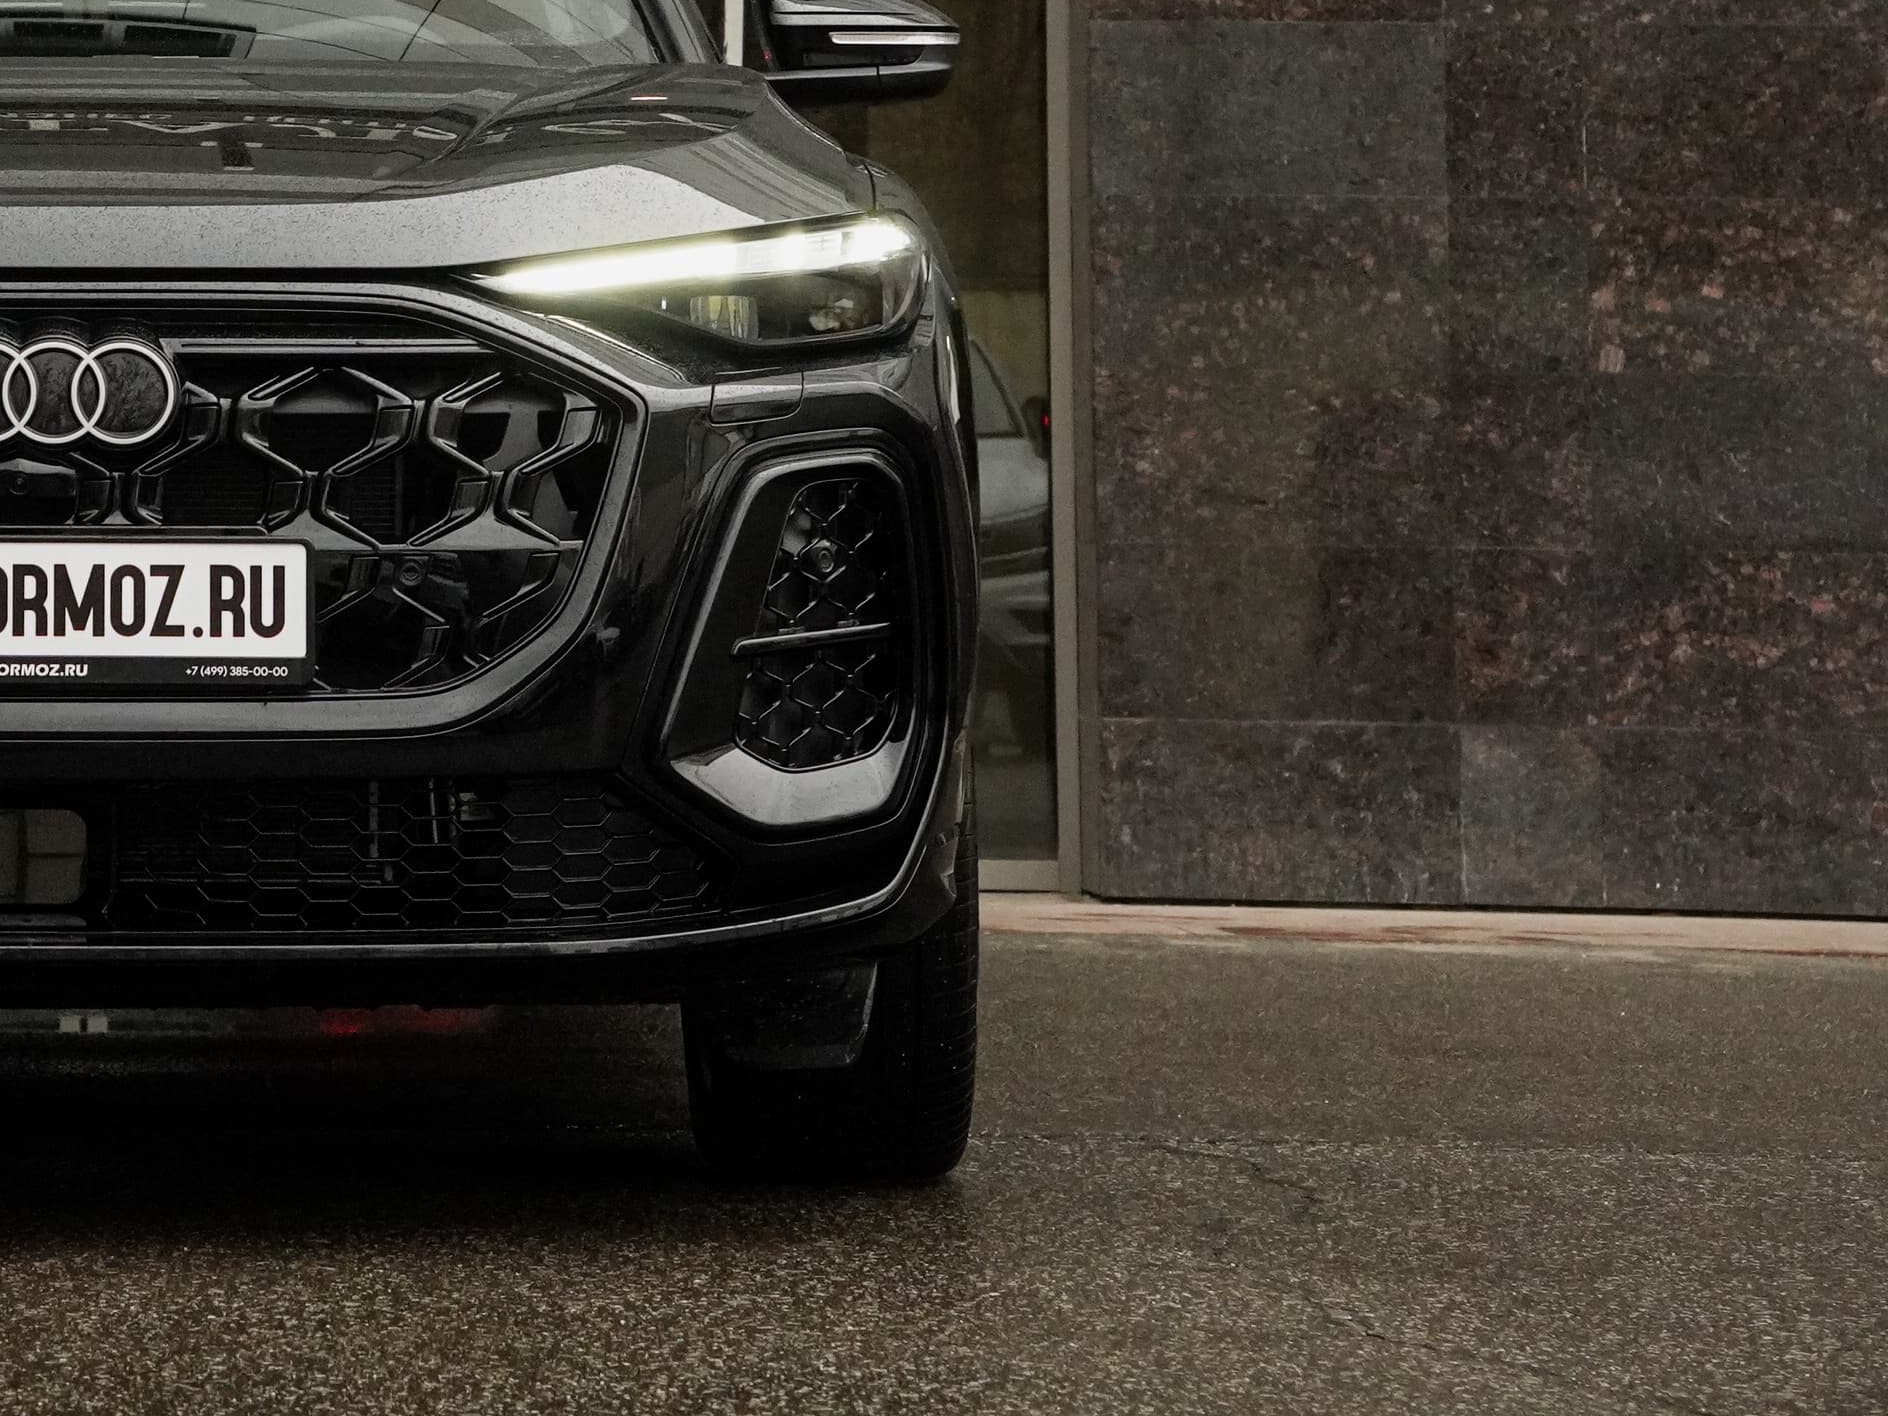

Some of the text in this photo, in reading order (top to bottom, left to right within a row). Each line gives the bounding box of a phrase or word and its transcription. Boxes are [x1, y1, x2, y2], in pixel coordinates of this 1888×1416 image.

[185, 665, 289, 678] +7 (499) 385-00-00
